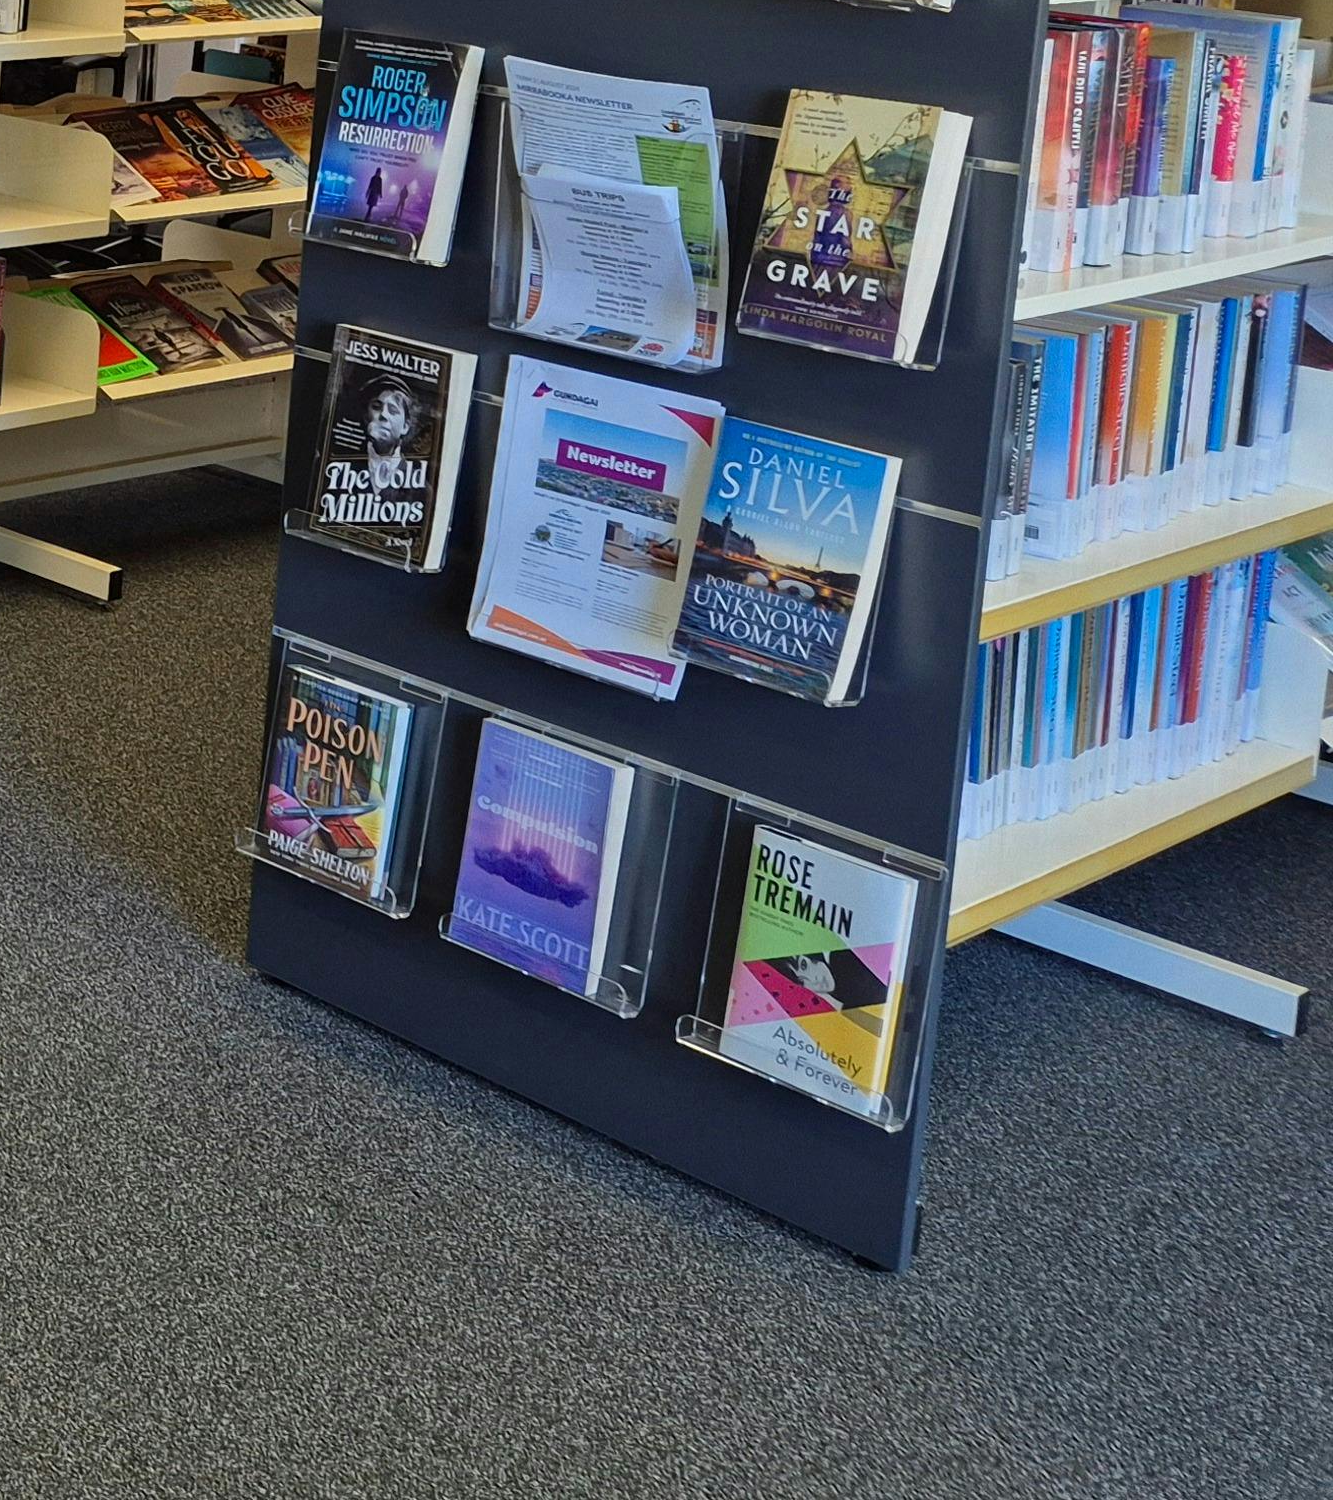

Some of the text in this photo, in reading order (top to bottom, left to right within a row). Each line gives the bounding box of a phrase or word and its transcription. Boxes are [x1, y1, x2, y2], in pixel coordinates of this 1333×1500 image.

[371, 64, 428, 95] ROGER
[516, 83, 634, 112] MIRRABOOKA NEWSLETTER
[338, 84, 447, 133] SIMPSON
[338, 120, 435, 155] RESURRECTION
[828, 186, 852, 203] The
[793, 206, 876, 240] STAR
[805, 241, 852, 257] on the
[171, 281, 225, 296] SPARROW
[766, 259, 882, 302] GRAVE
[743, 304, 776, 320] LINDA
[780, 310, 844, 334] MARGOLIN
[846, 324, 888, 344] ROYAL
[344, 339, 379, 361] JESS
[380, 347, 442, 377] WALTER
[1024, 356, 1042, 451] THE IMITATOR
[324, 459, 429, 495] The Cold
[566, 444, 657, 481] Newsletter
[747, 446, 846, 490] DANIEL
[317, 491, 425, 528] Millions
[717, 460, 860, 536] SILVA
[692, 584, 837, 648] UNKNOWN
[705, 573, 834, 623] PORTRAIT OF AN
[708, 610, 813, 661] WOMAN
[286, 697, 383, 764] POISON
[303, 738, 355, 790] PEN
[477, 794, 600, 855] Compulsion
[268, 829, 309, 857] PAIGE
[309, 846, 370, 885] SHELTON
[756, 843, 815, 891] ROSE
[753, 873, 854, 939] TREMAIN
[456, 894, 590, 969] KATE SCOTT
[772, 1025, 863, 1079] Absolutely
[775, 1047, 859, 1097] & Forever
